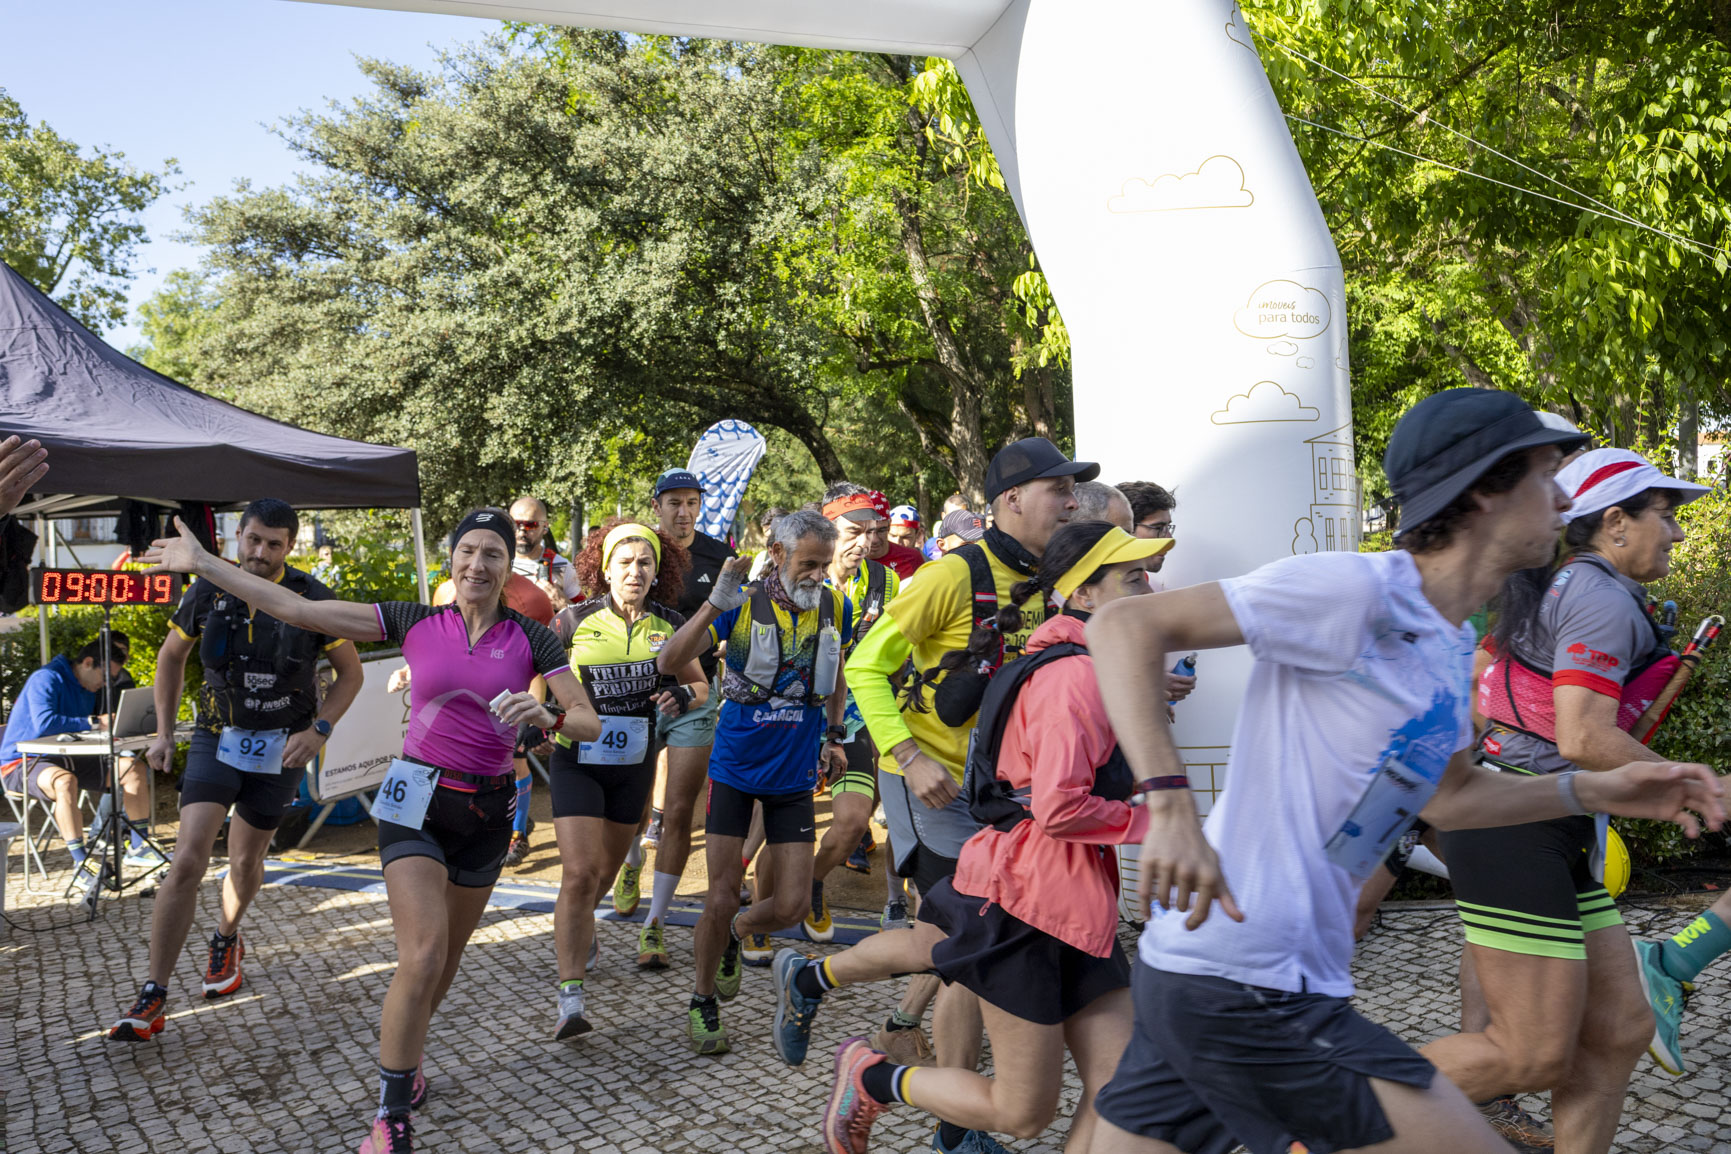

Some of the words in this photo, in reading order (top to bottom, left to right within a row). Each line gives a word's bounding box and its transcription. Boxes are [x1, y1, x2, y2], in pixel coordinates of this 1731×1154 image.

[1258, 312, 1287, 326] para
[1291, 311, 1320, 325] todos
[41, 571, 172, 604] 09:00:19
[589, 662, 655, 681] TRILHO
[592, 677, 657, 697] PERDIDO
[752, 708, 804, 723] CARACOL
[240, 737, 267, 757] 92
[602, 730, 628, 749] 49
[325, 763, 357, 778] ESTAMOS
[375, 755, 388, 765] POR
[382, 776, 408, 804] 46
[1671, 916, 1712, 949] NOW
